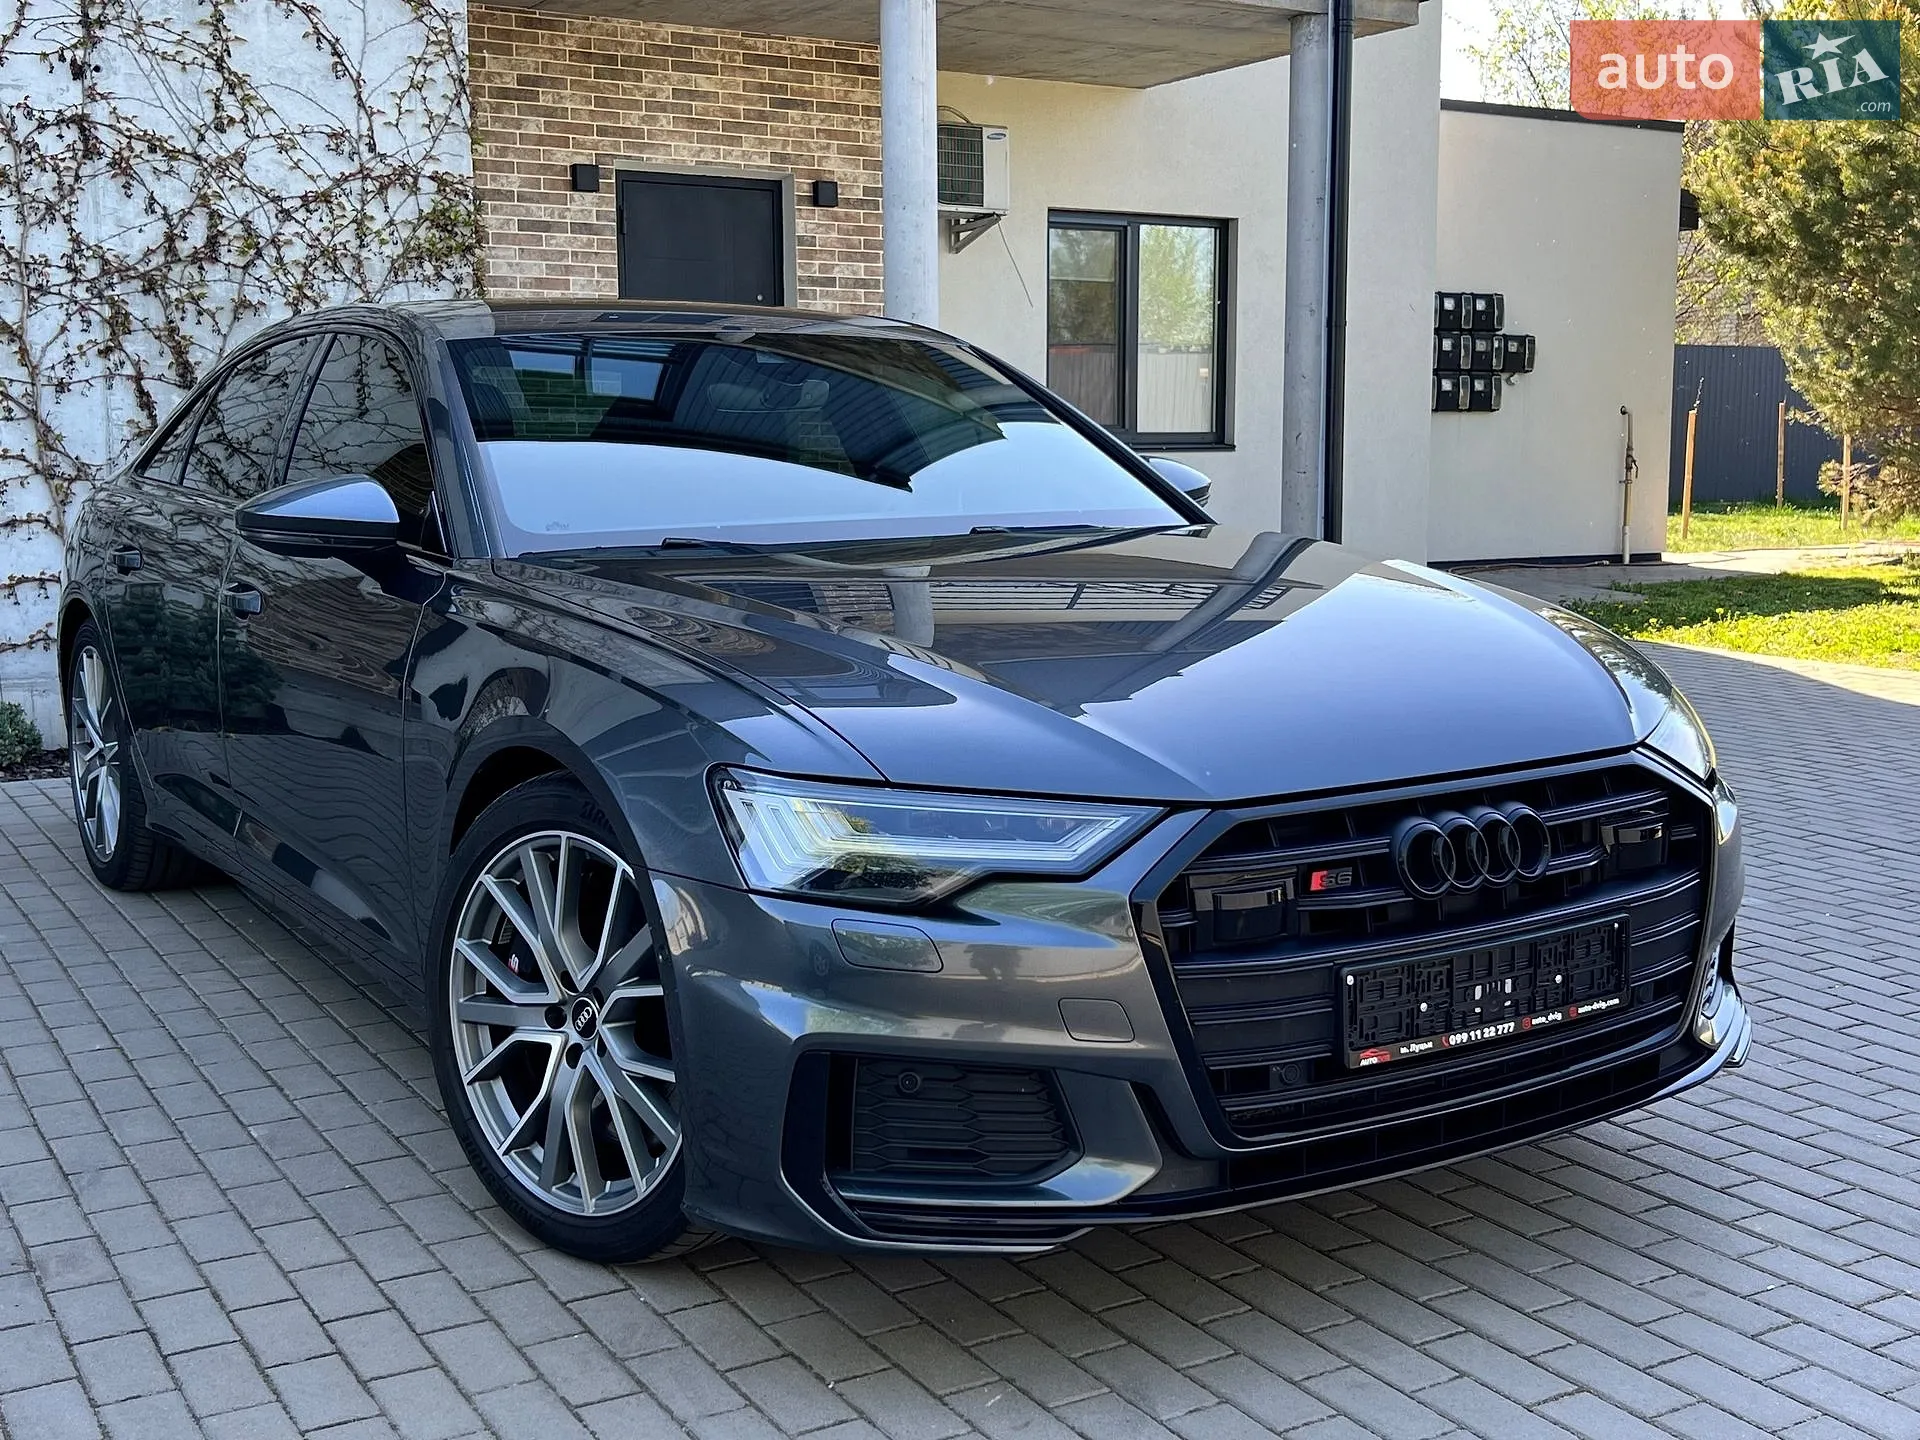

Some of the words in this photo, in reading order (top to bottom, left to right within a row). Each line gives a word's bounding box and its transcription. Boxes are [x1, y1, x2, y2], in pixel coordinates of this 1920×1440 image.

[1319, 869, 1352, 890] S6
[1449, 1032, 1468, 1045] 099
[1470, 1029, 1481, 1040] 11
[1483, 1026, 1496, 1038] 22
[1497, 1021, 1515, 1035] 777
